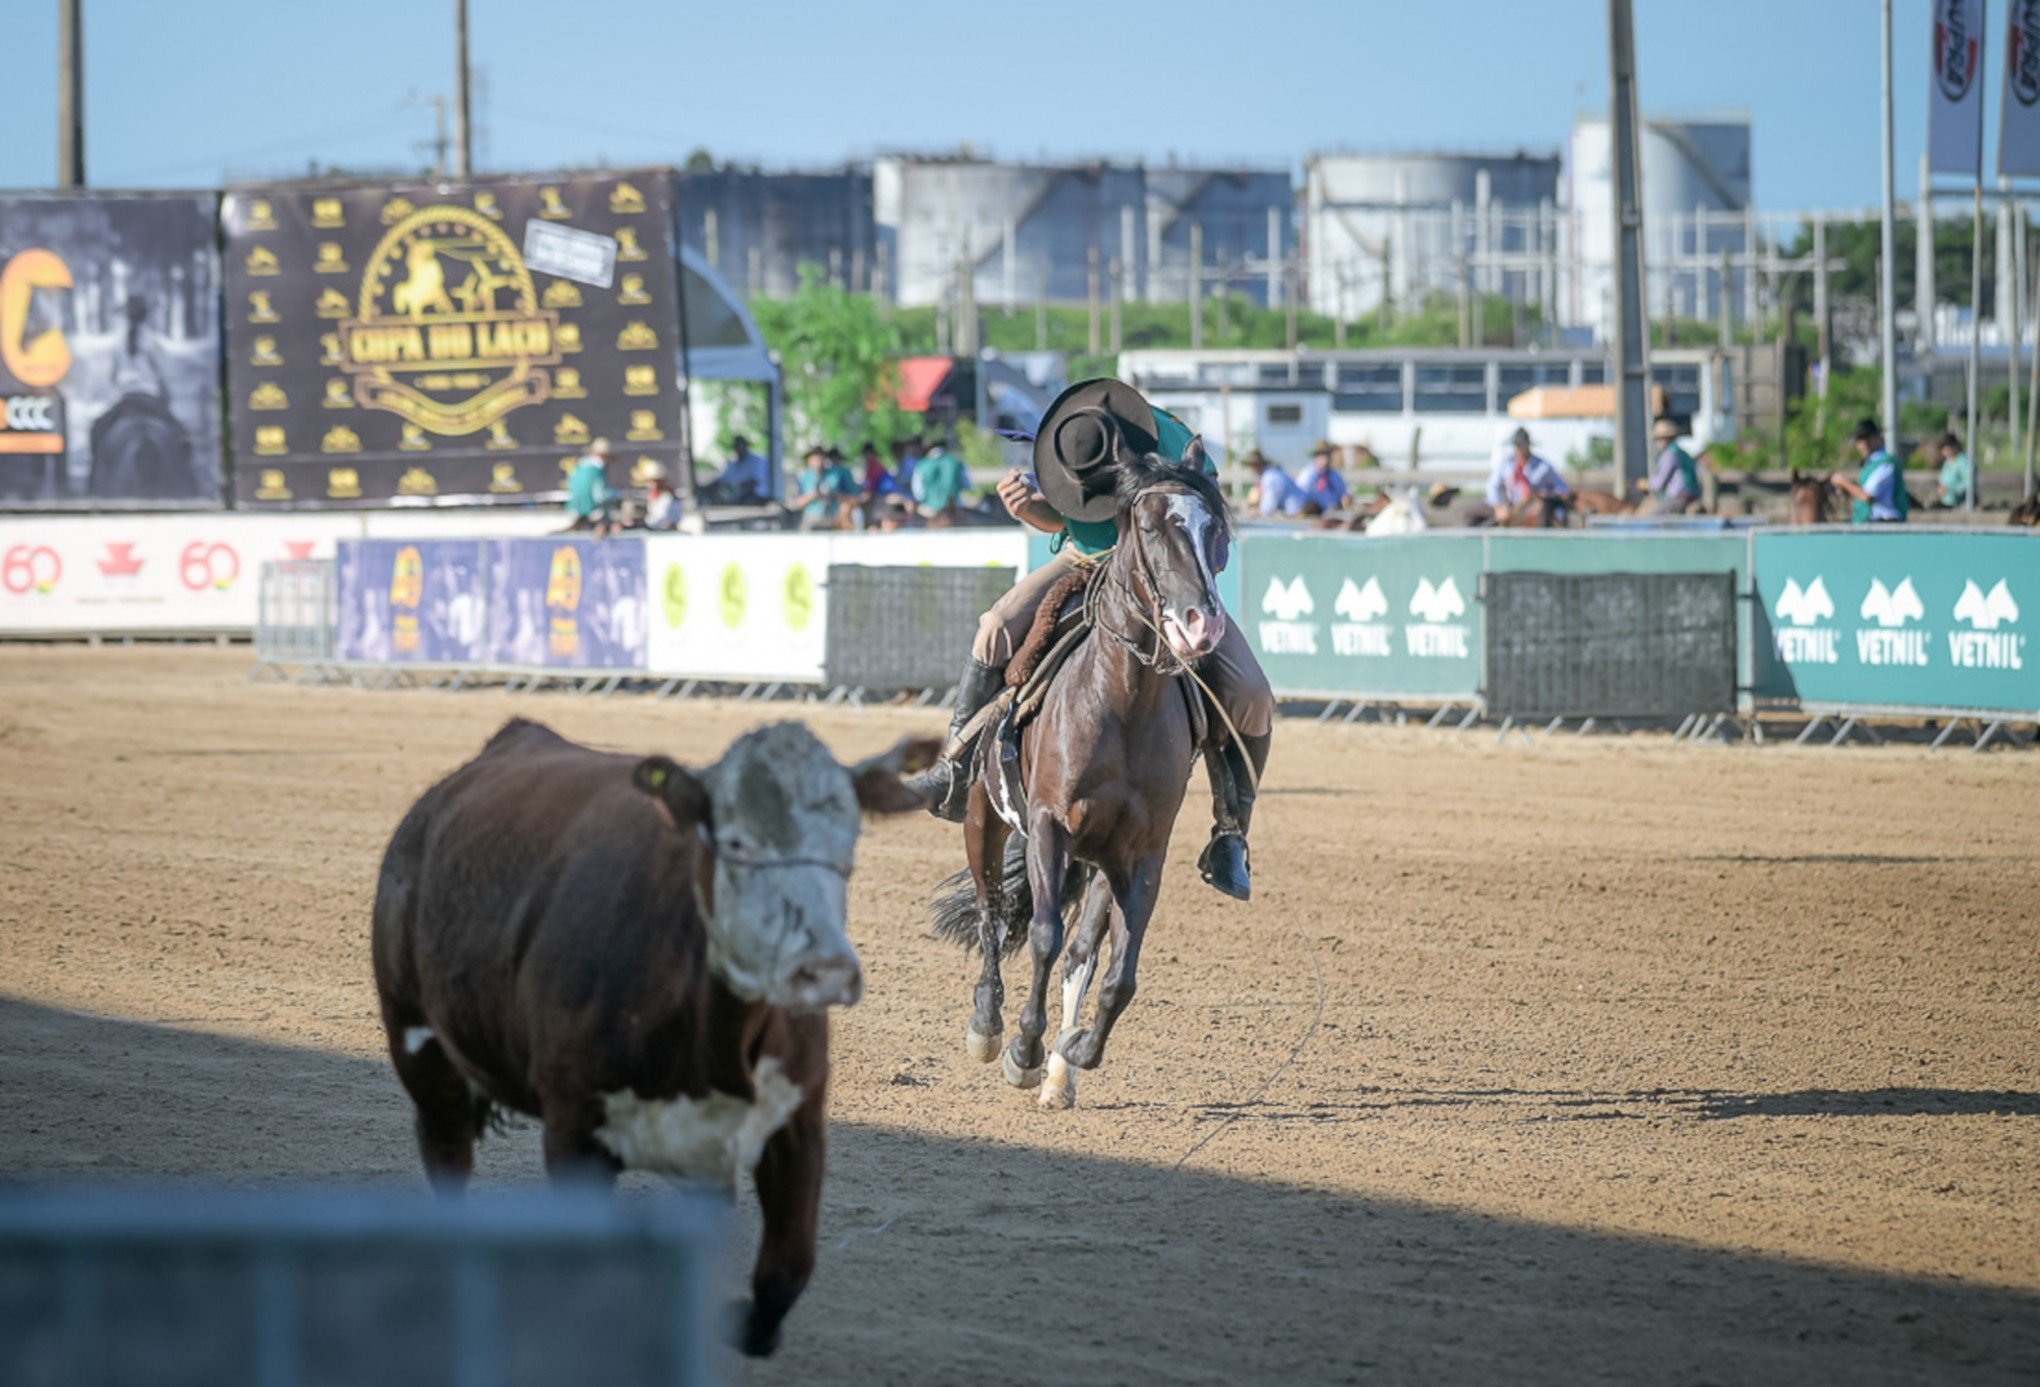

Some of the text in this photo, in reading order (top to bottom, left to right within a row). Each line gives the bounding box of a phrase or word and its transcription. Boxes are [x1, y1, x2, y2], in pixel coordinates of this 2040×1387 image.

[351, 327, 425, 363] COPA
[428, 323, 472, 359] DO
[2, 544, 62, 595] 60
[179, 540, 240, 591] 60
[1772, 627, 1840, 664] VETNIL
[1855, 628, 1930, 666] VETNIL
[1948, 630, 2025, 670] VETNIL
